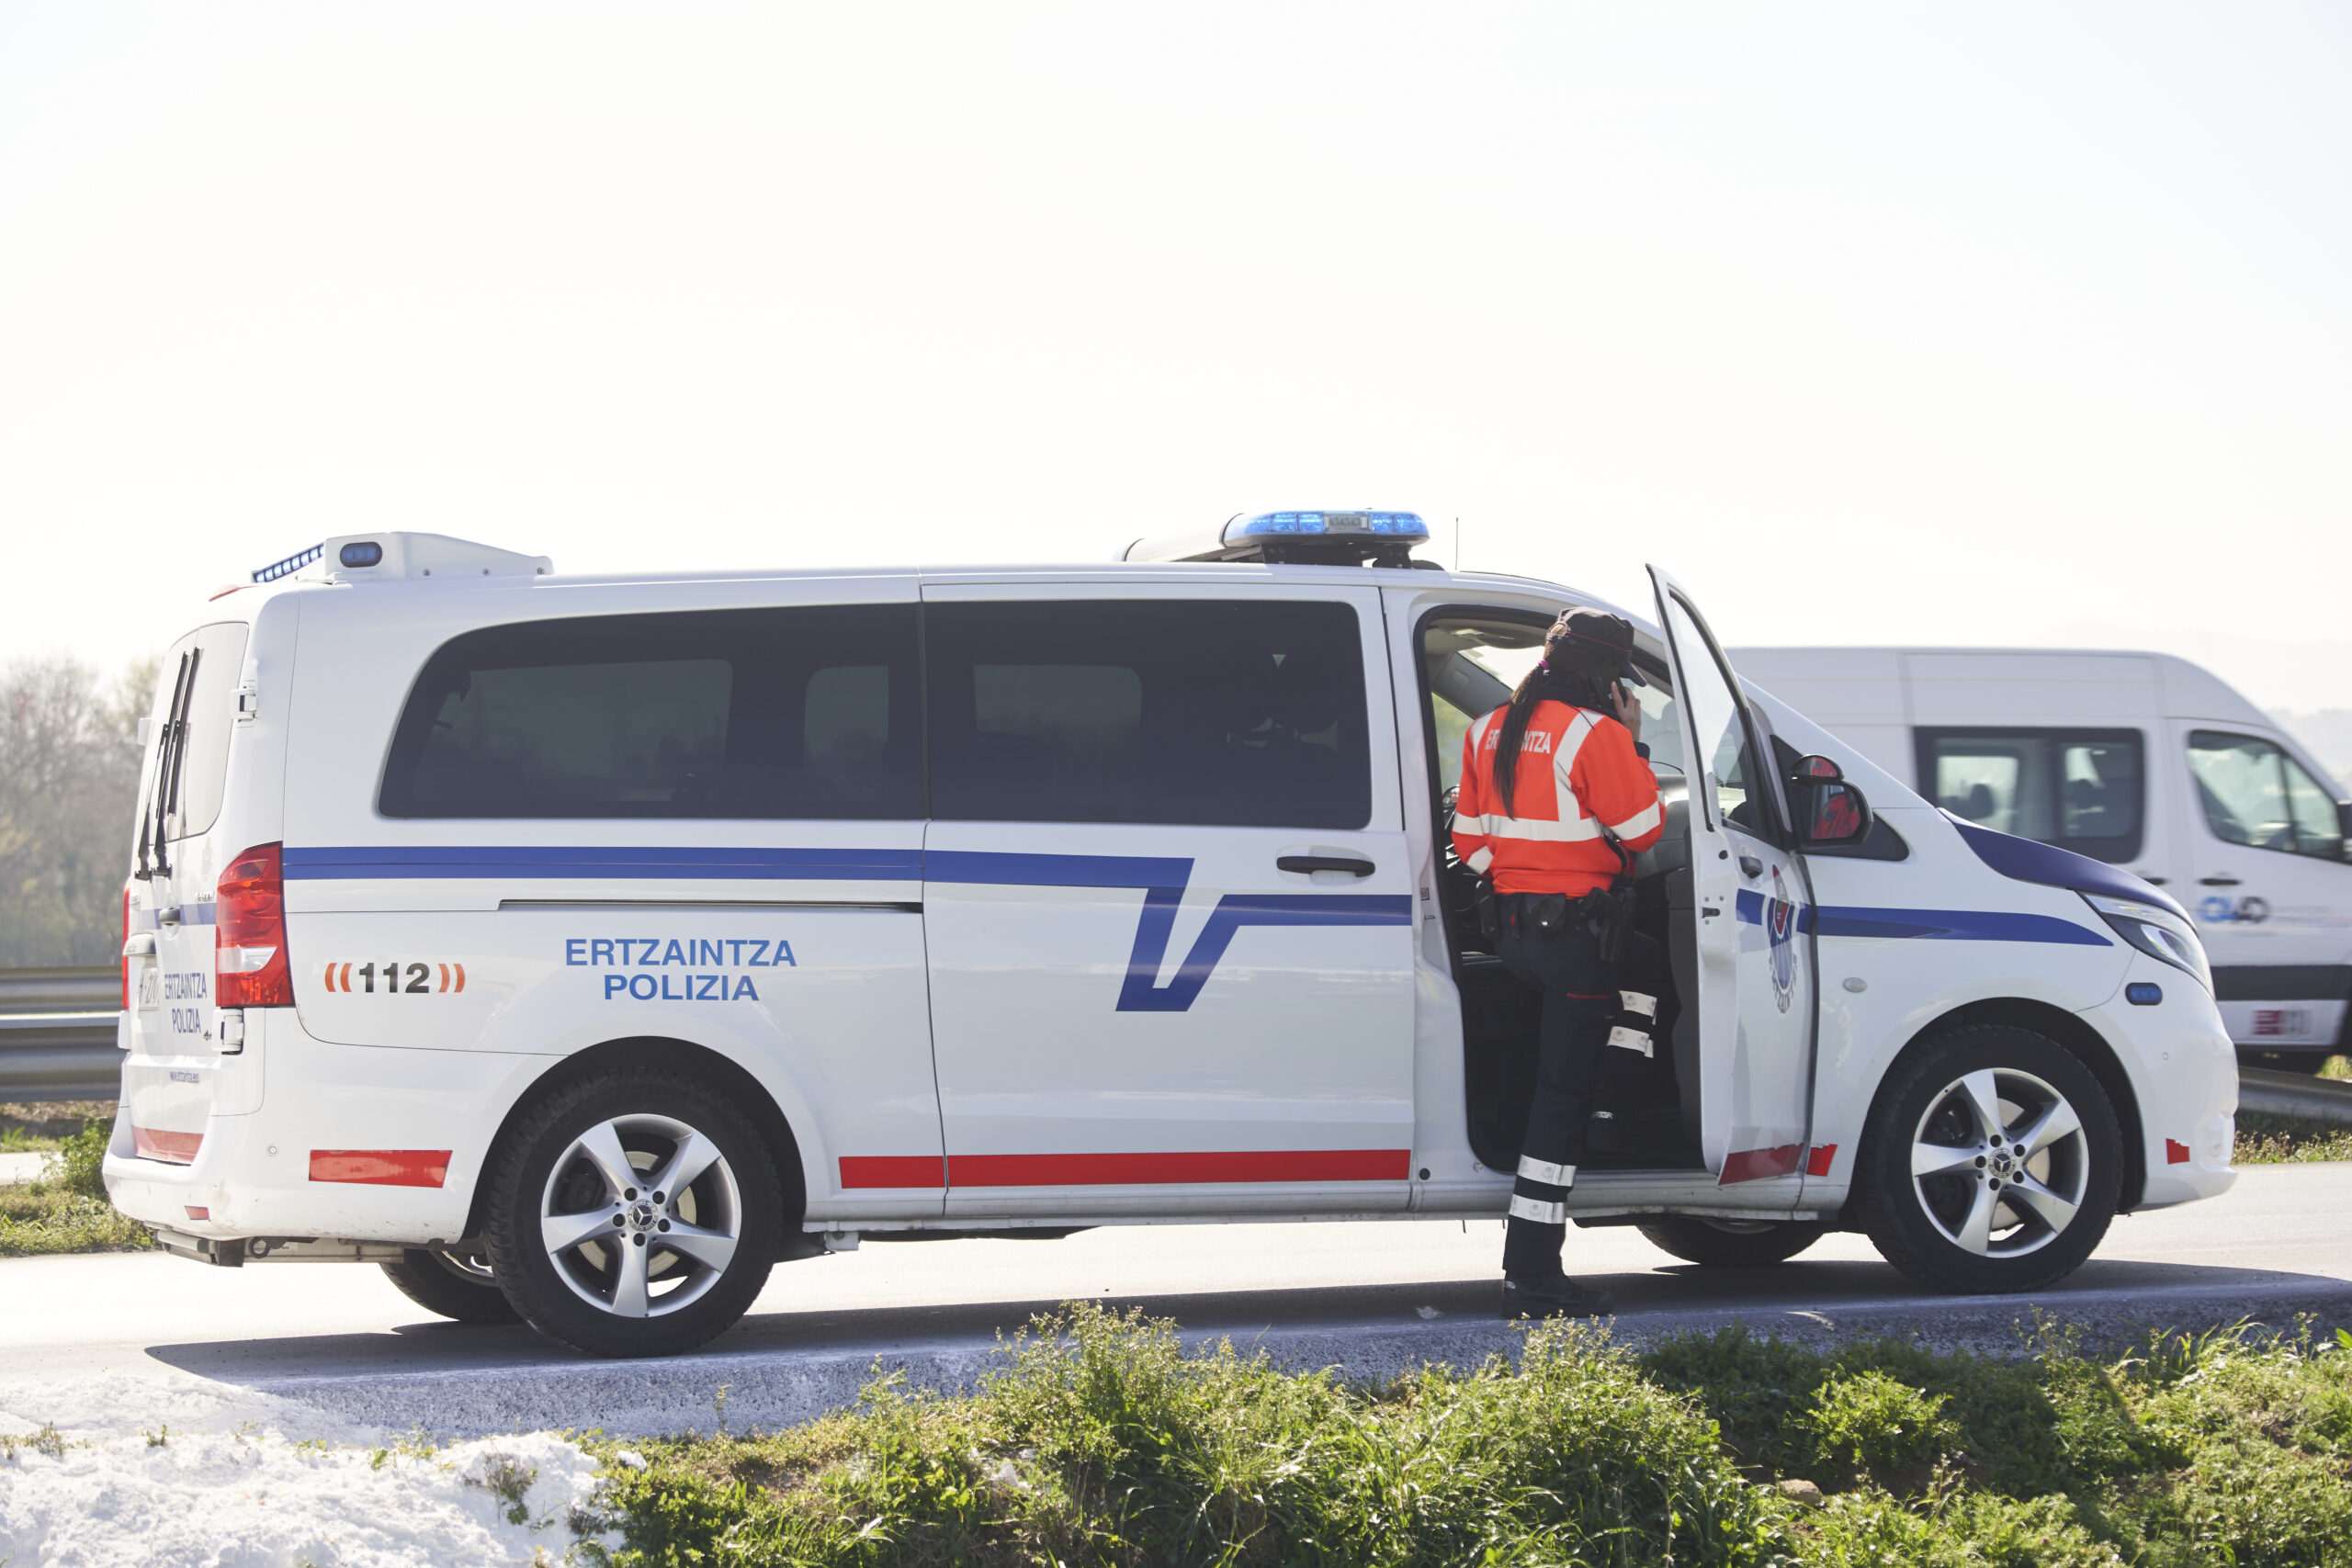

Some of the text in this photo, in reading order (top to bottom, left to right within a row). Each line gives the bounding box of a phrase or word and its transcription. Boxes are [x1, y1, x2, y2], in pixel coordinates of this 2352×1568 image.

[1485, 728, 1551, 754] ERNTZA
[565, 939, 797, 966] ERTZAINTZA
[164, 972, 208, 1000] ERTZAINTZA
[604, 974, 760, 1001] POLIZIA
[171, 1008, 201, 1034] POLIZIA
